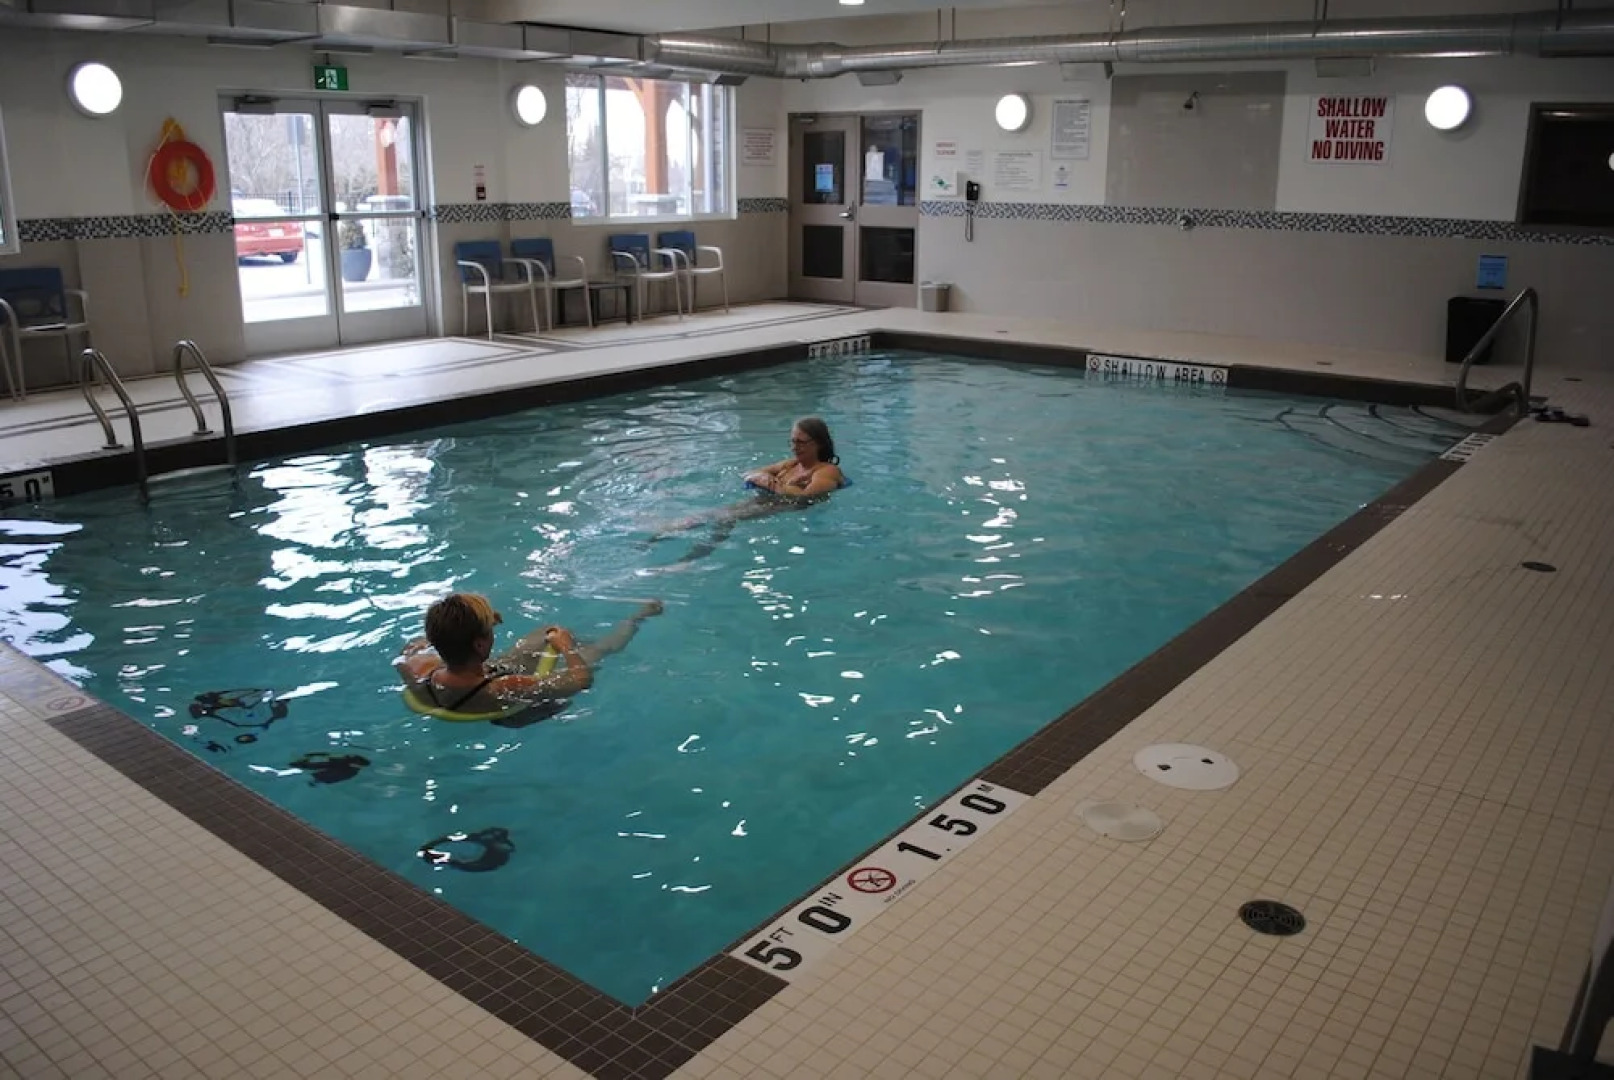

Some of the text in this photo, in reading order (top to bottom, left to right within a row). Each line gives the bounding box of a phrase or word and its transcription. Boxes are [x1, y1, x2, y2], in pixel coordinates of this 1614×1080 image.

[1317, 97, 1387, 117] SHALLOW
[1325, 119, 1375, 138] WATER
[1311, 140, 1384, 161] NO DIVING
[1104, 359, 1204, 383] SHALLOW AREA
